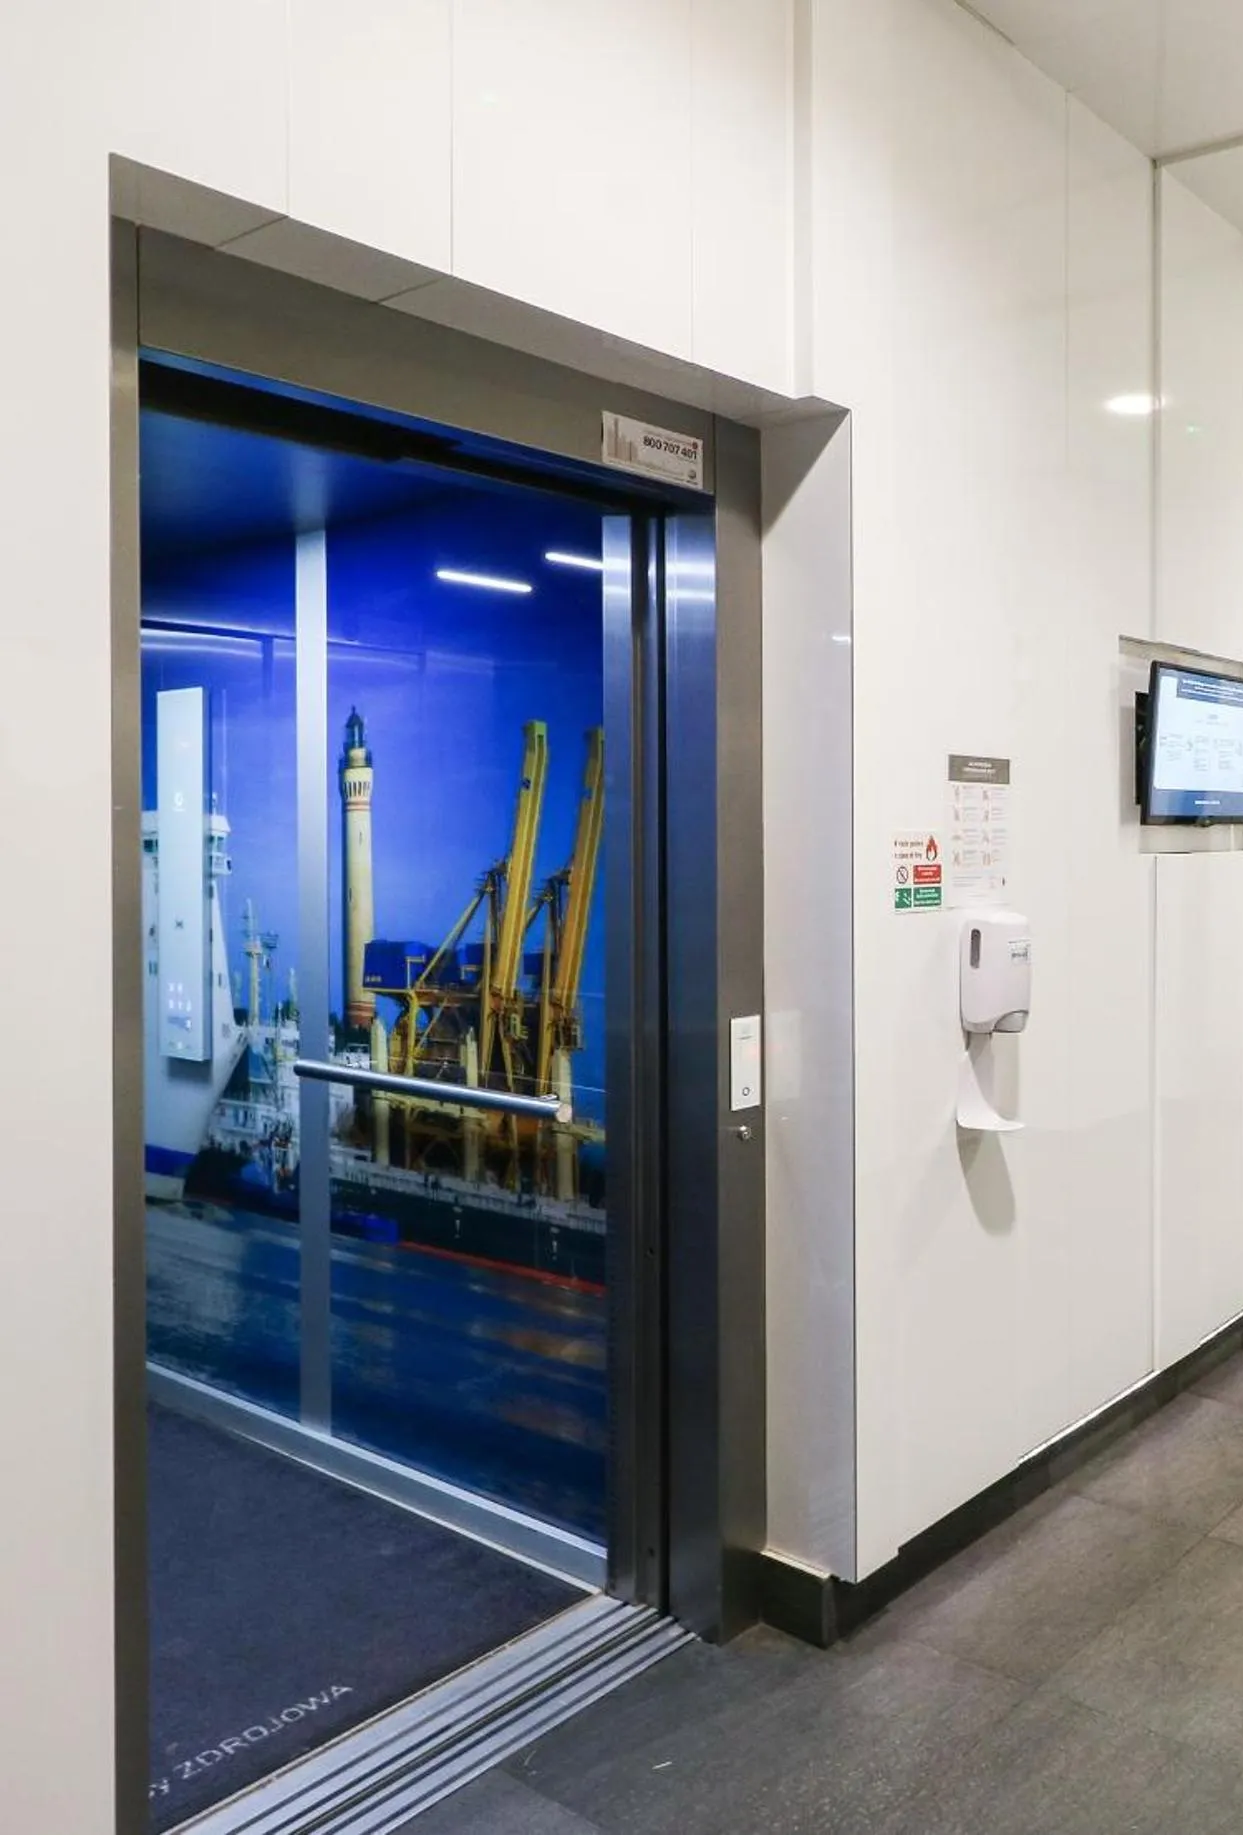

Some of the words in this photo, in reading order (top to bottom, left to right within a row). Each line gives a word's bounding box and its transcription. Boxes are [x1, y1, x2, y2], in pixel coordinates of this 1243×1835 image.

[643, 435, 662, 450] 800
[663, 441, 681, 455] 707
[173, 1684, 353, 1780] ZDROJOWA
